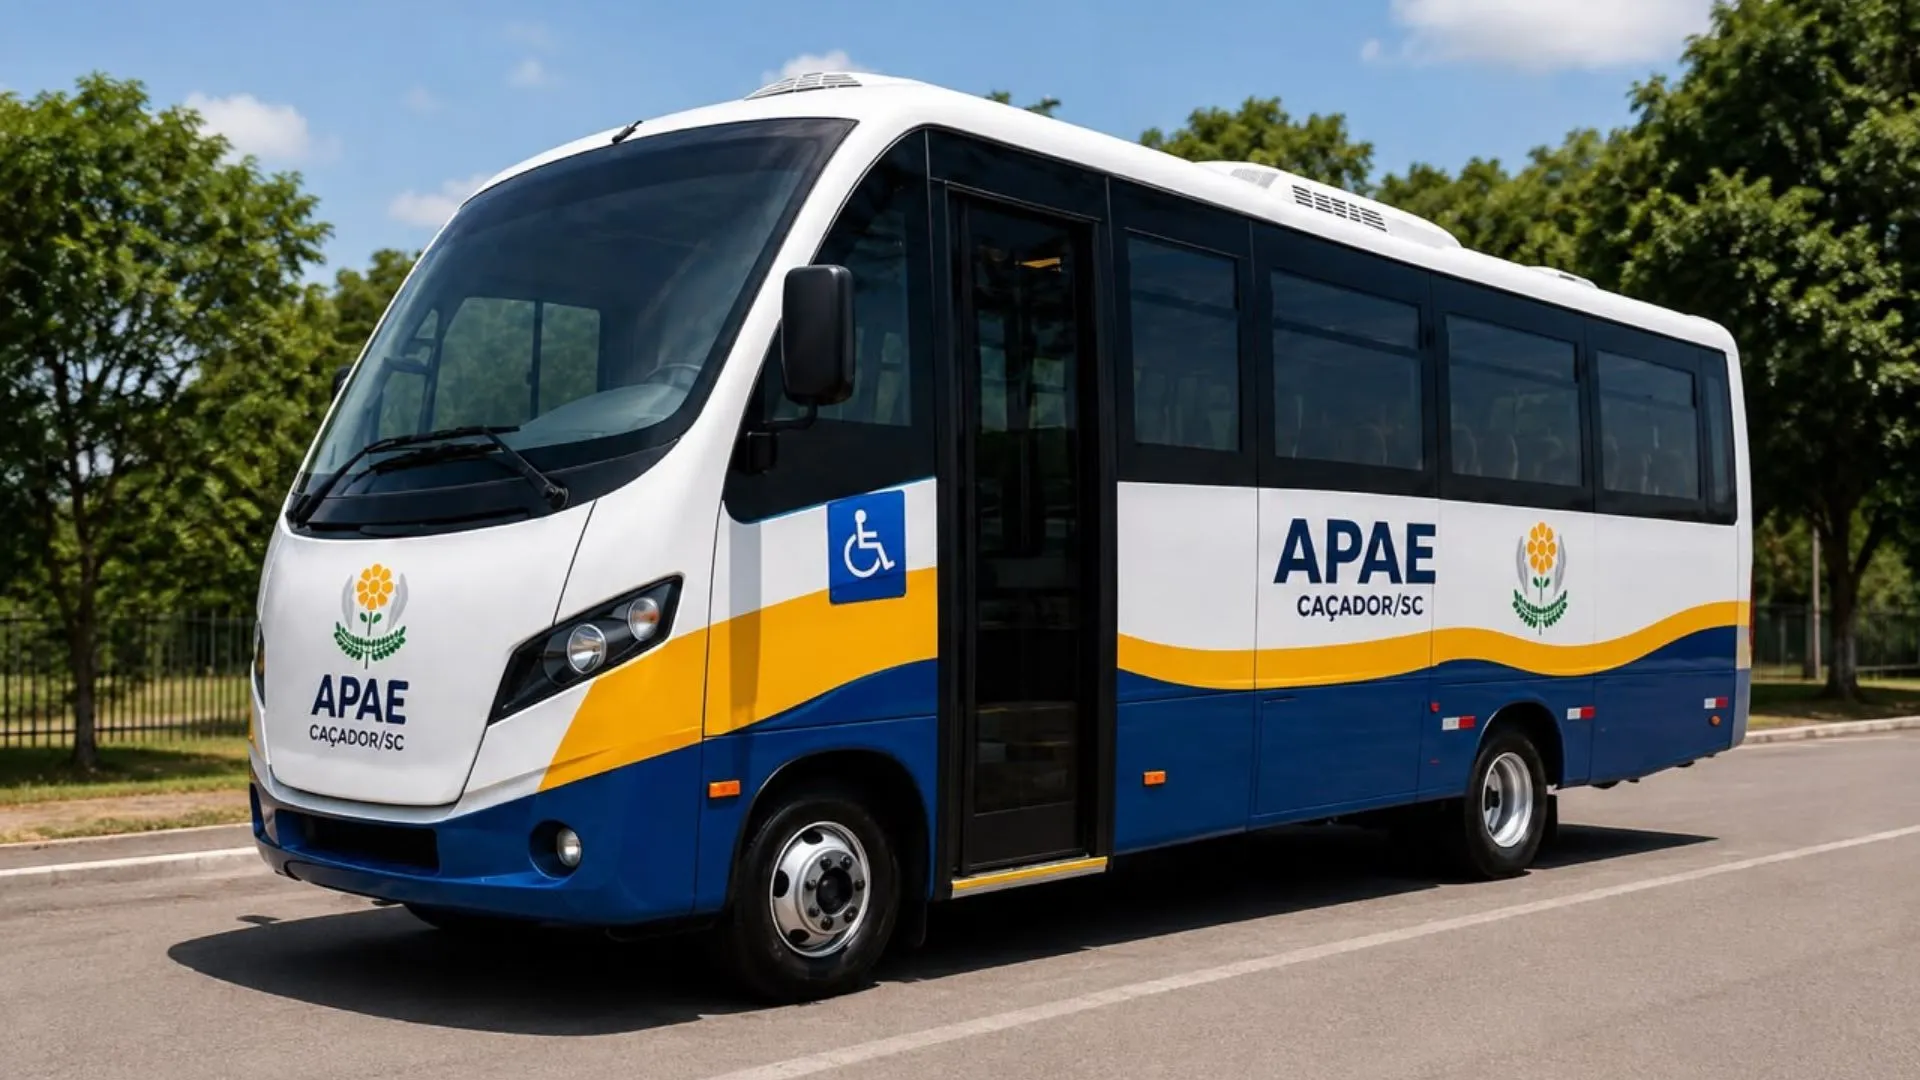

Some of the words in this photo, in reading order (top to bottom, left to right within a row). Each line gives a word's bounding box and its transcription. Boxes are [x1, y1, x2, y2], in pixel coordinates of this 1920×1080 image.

[1273, 518, 1437, 585] APAE
[1297, 593, 1424, 622] CAÇADOR/SC
[311, 674, 409, 725] APAE
[309, 724, 405, 751] CAÇADOR/SC
